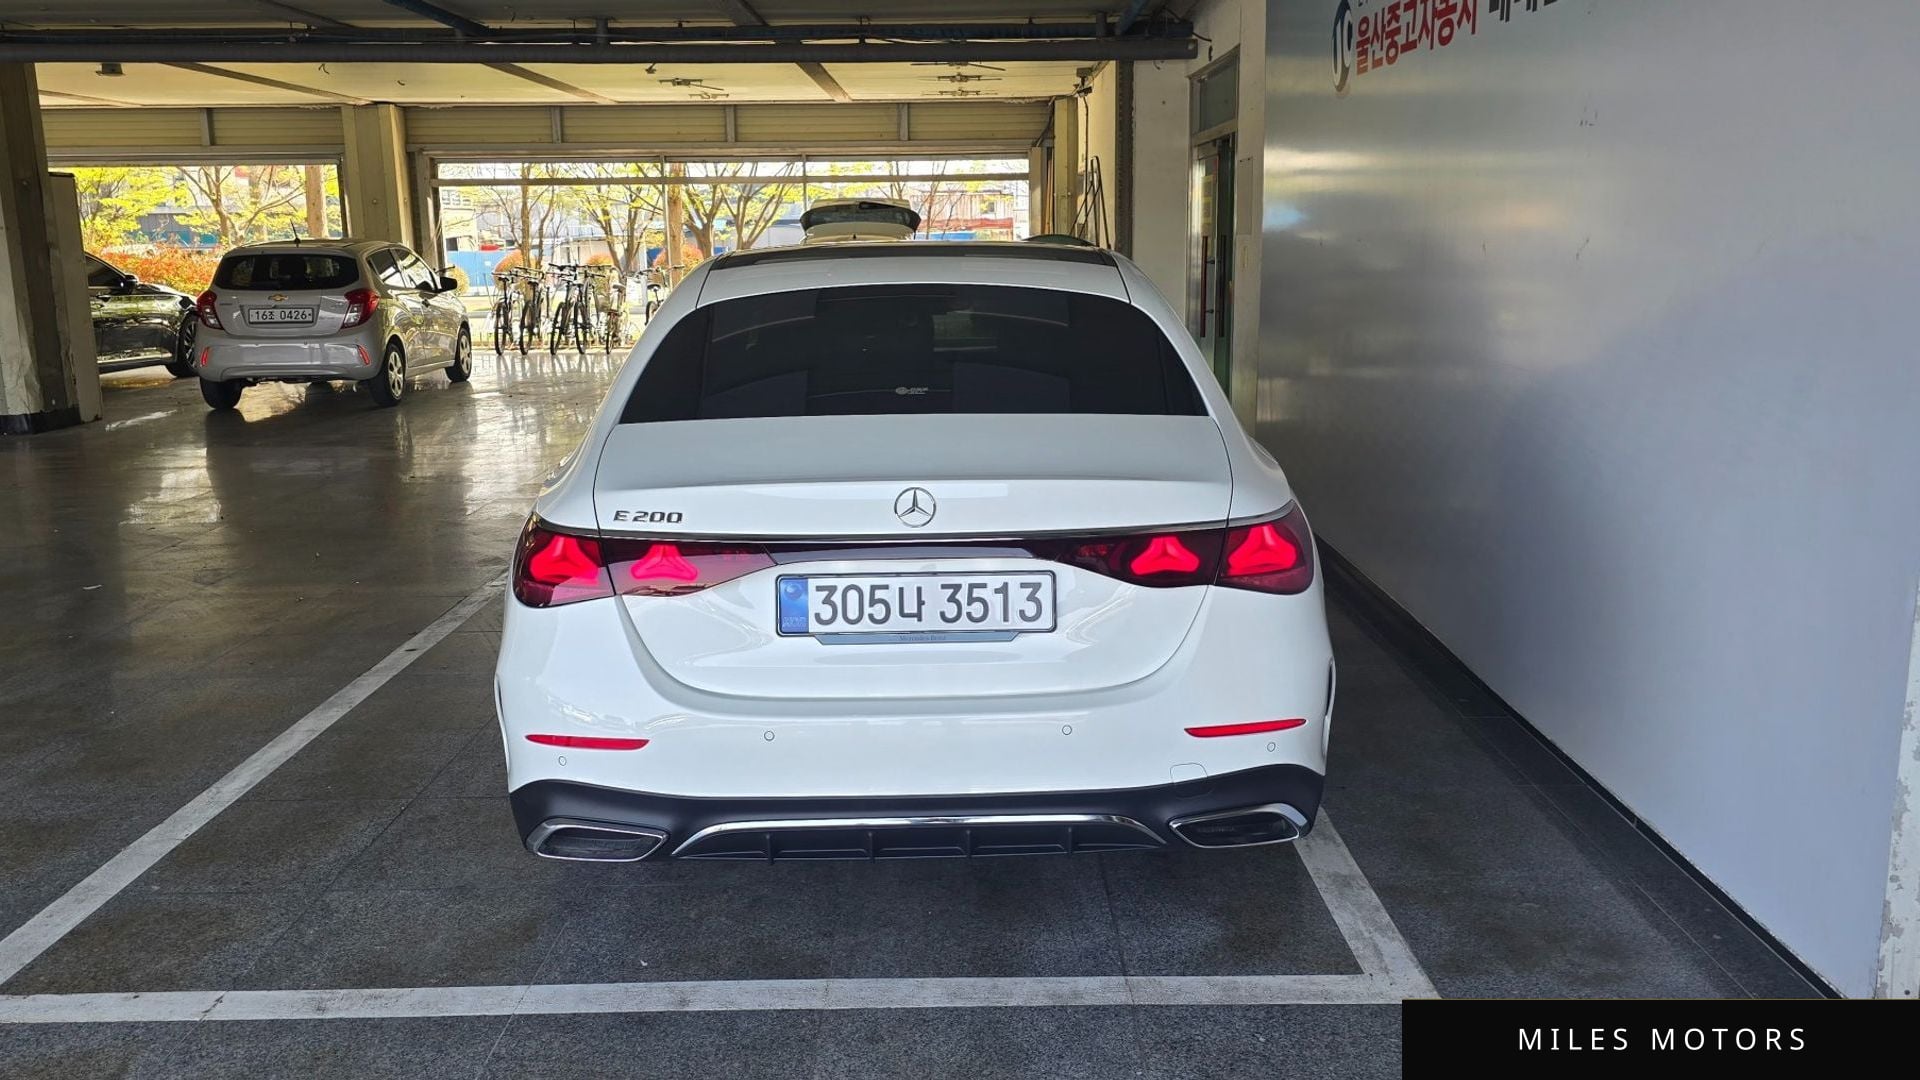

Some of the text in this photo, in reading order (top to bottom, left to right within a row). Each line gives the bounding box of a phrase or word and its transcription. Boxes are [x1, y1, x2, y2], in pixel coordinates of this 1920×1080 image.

[280, 310, 307, 321] 0426
[613, 510, 683, 524] E 200
[814, 582, 1043, 626] 305나 3513
